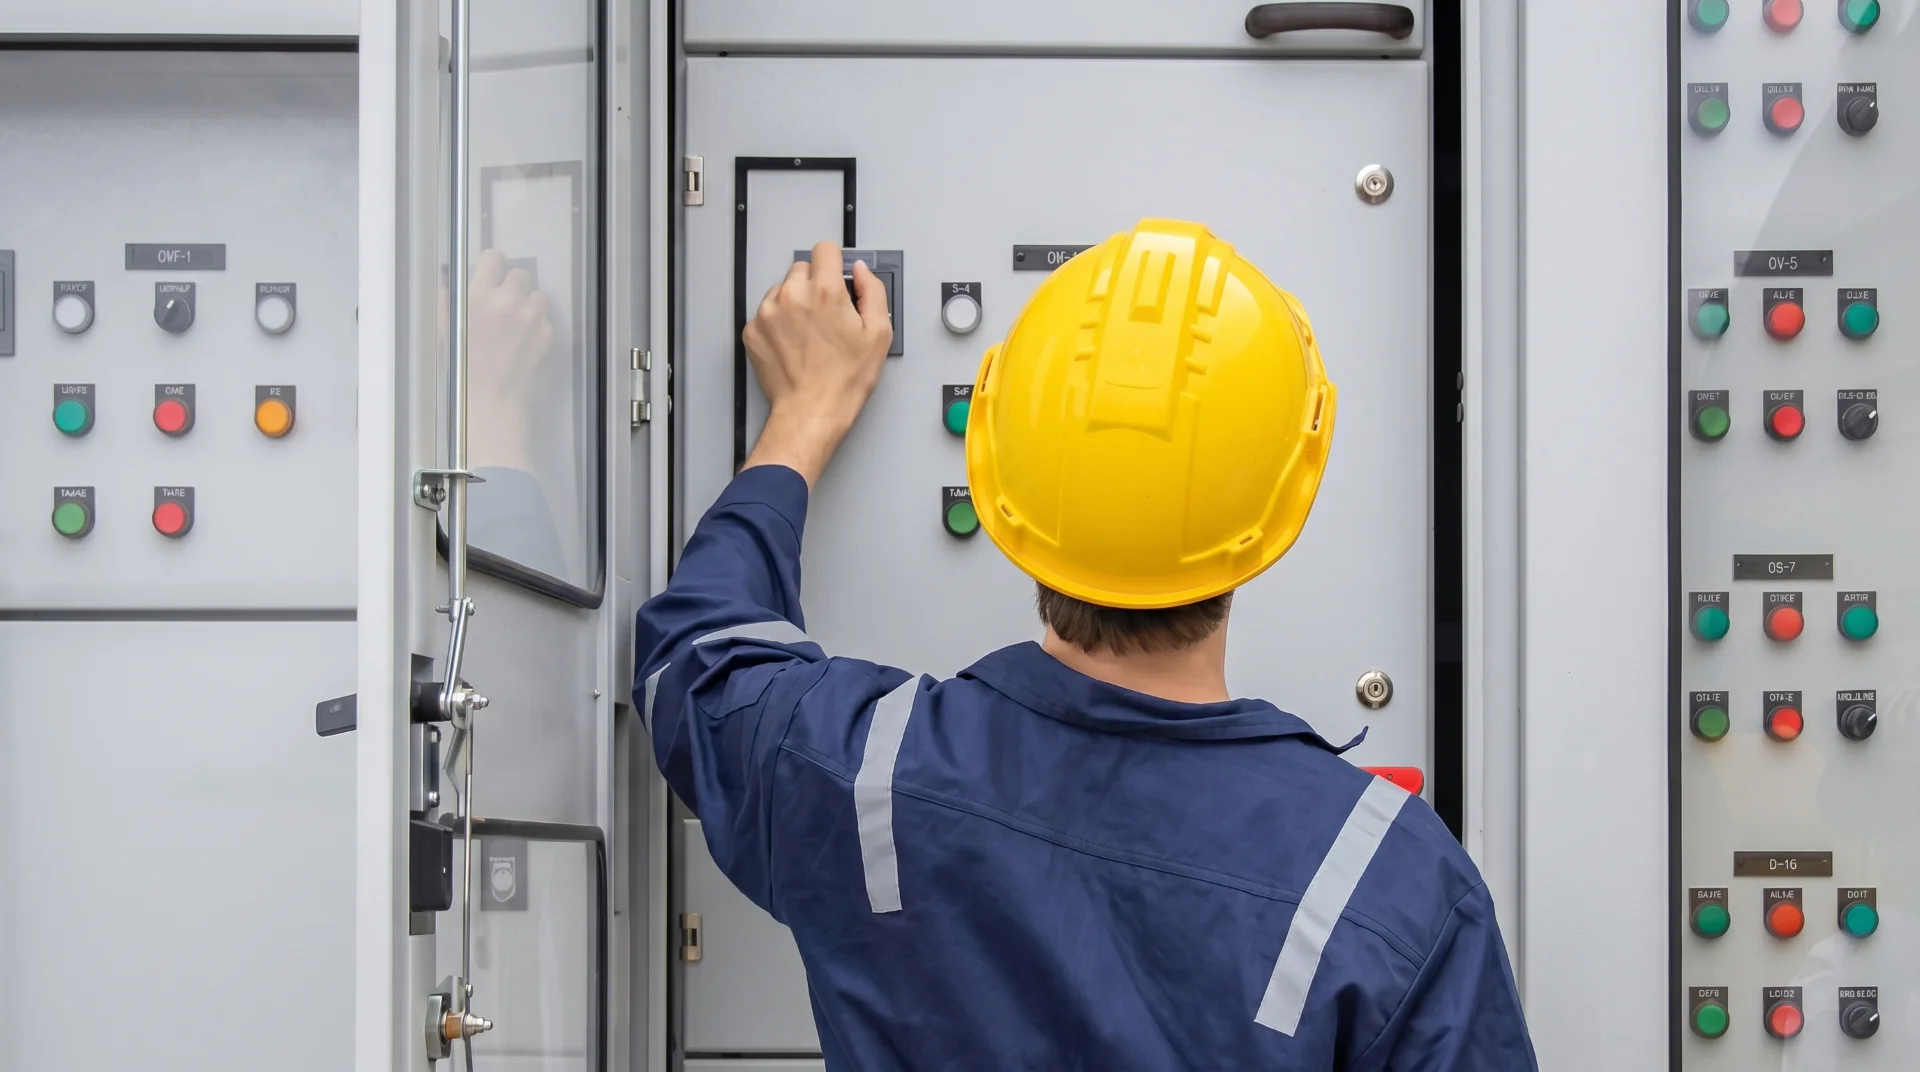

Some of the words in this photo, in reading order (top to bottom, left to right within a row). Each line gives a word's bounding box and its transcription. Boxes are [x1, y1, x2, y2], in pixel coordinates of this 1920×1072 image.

[1768, 256, 1797, 270] OV-5
[1768, 561, 1796, 574] OS-7
[1769, 858, 1797, 870] D-16
